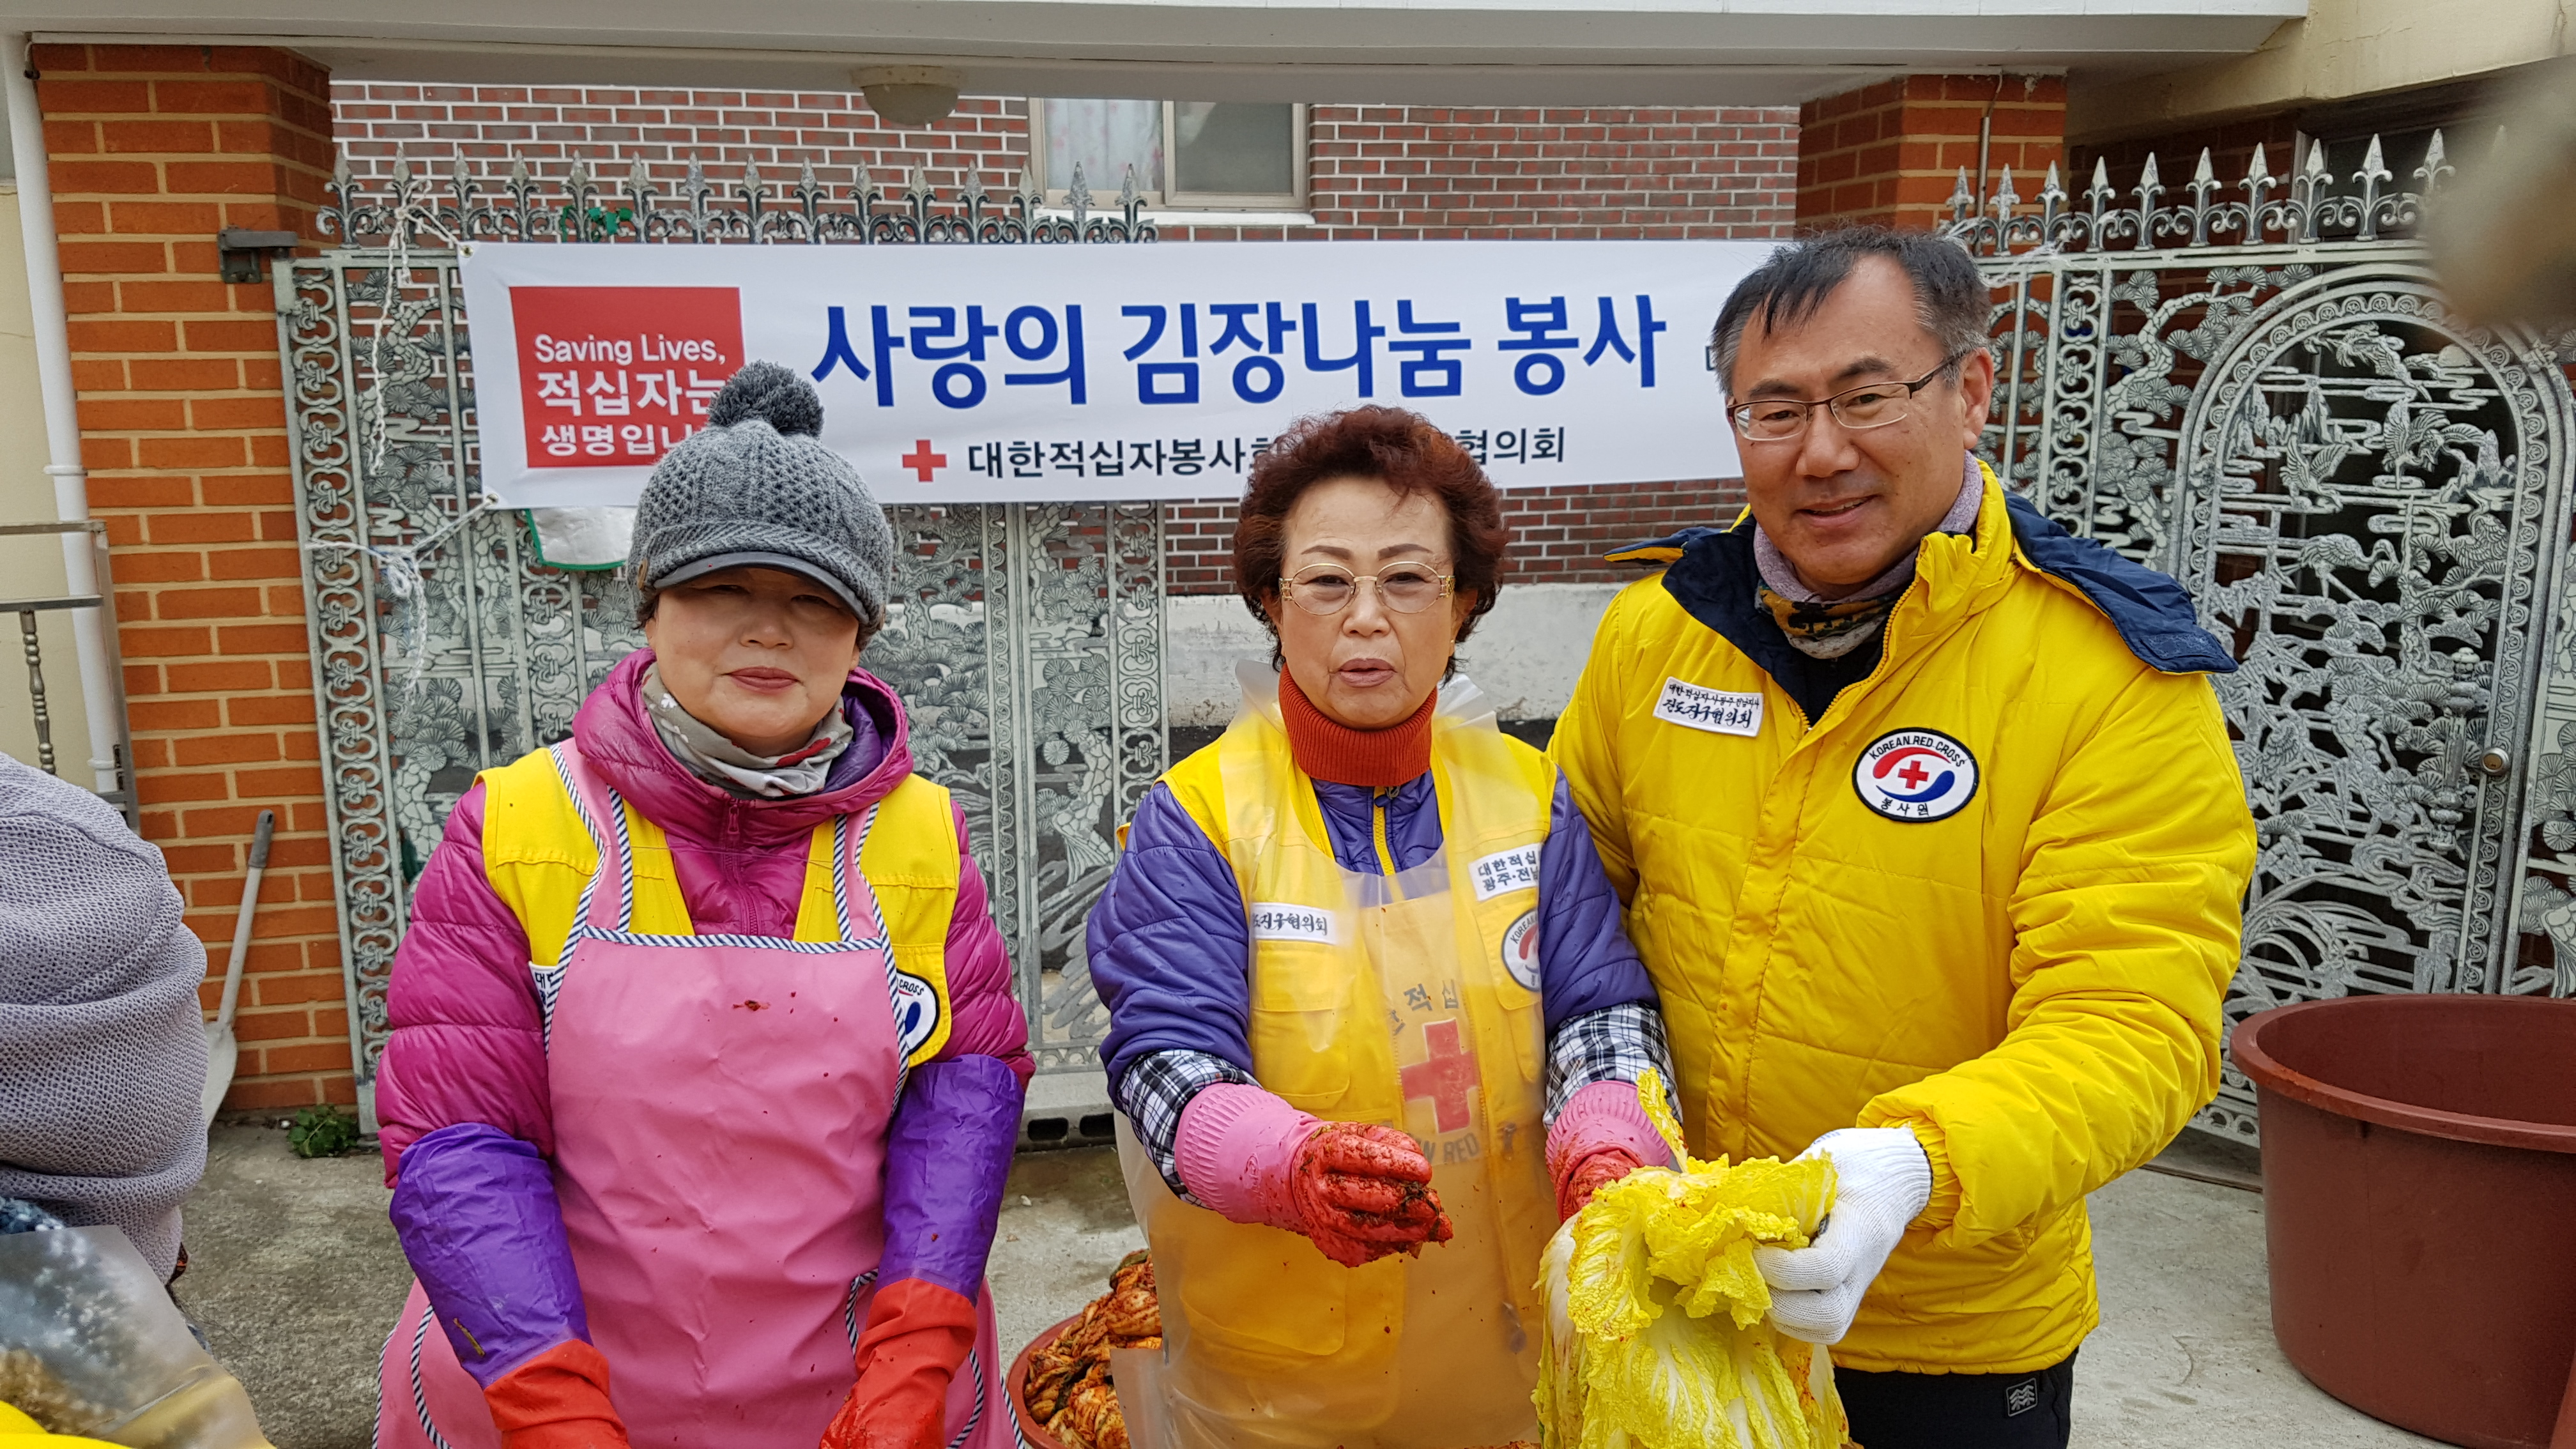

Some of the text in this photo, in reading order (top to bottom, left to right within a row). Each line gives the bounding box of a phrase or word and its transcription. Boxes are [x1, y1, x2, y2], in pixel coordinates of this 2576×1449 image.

[535, 334, 726, 365] Saving Lives,
[811, 295, 1667, 410] 사랑의 김장나눔 봉사
[537, 369, 726, 417] 적십자는
[1868, 735, 1965, 767] KOREAN RED CROSS
[1478, 850, 1541, 876] 대한적십
[898, 978, 924, 996] CROSS
